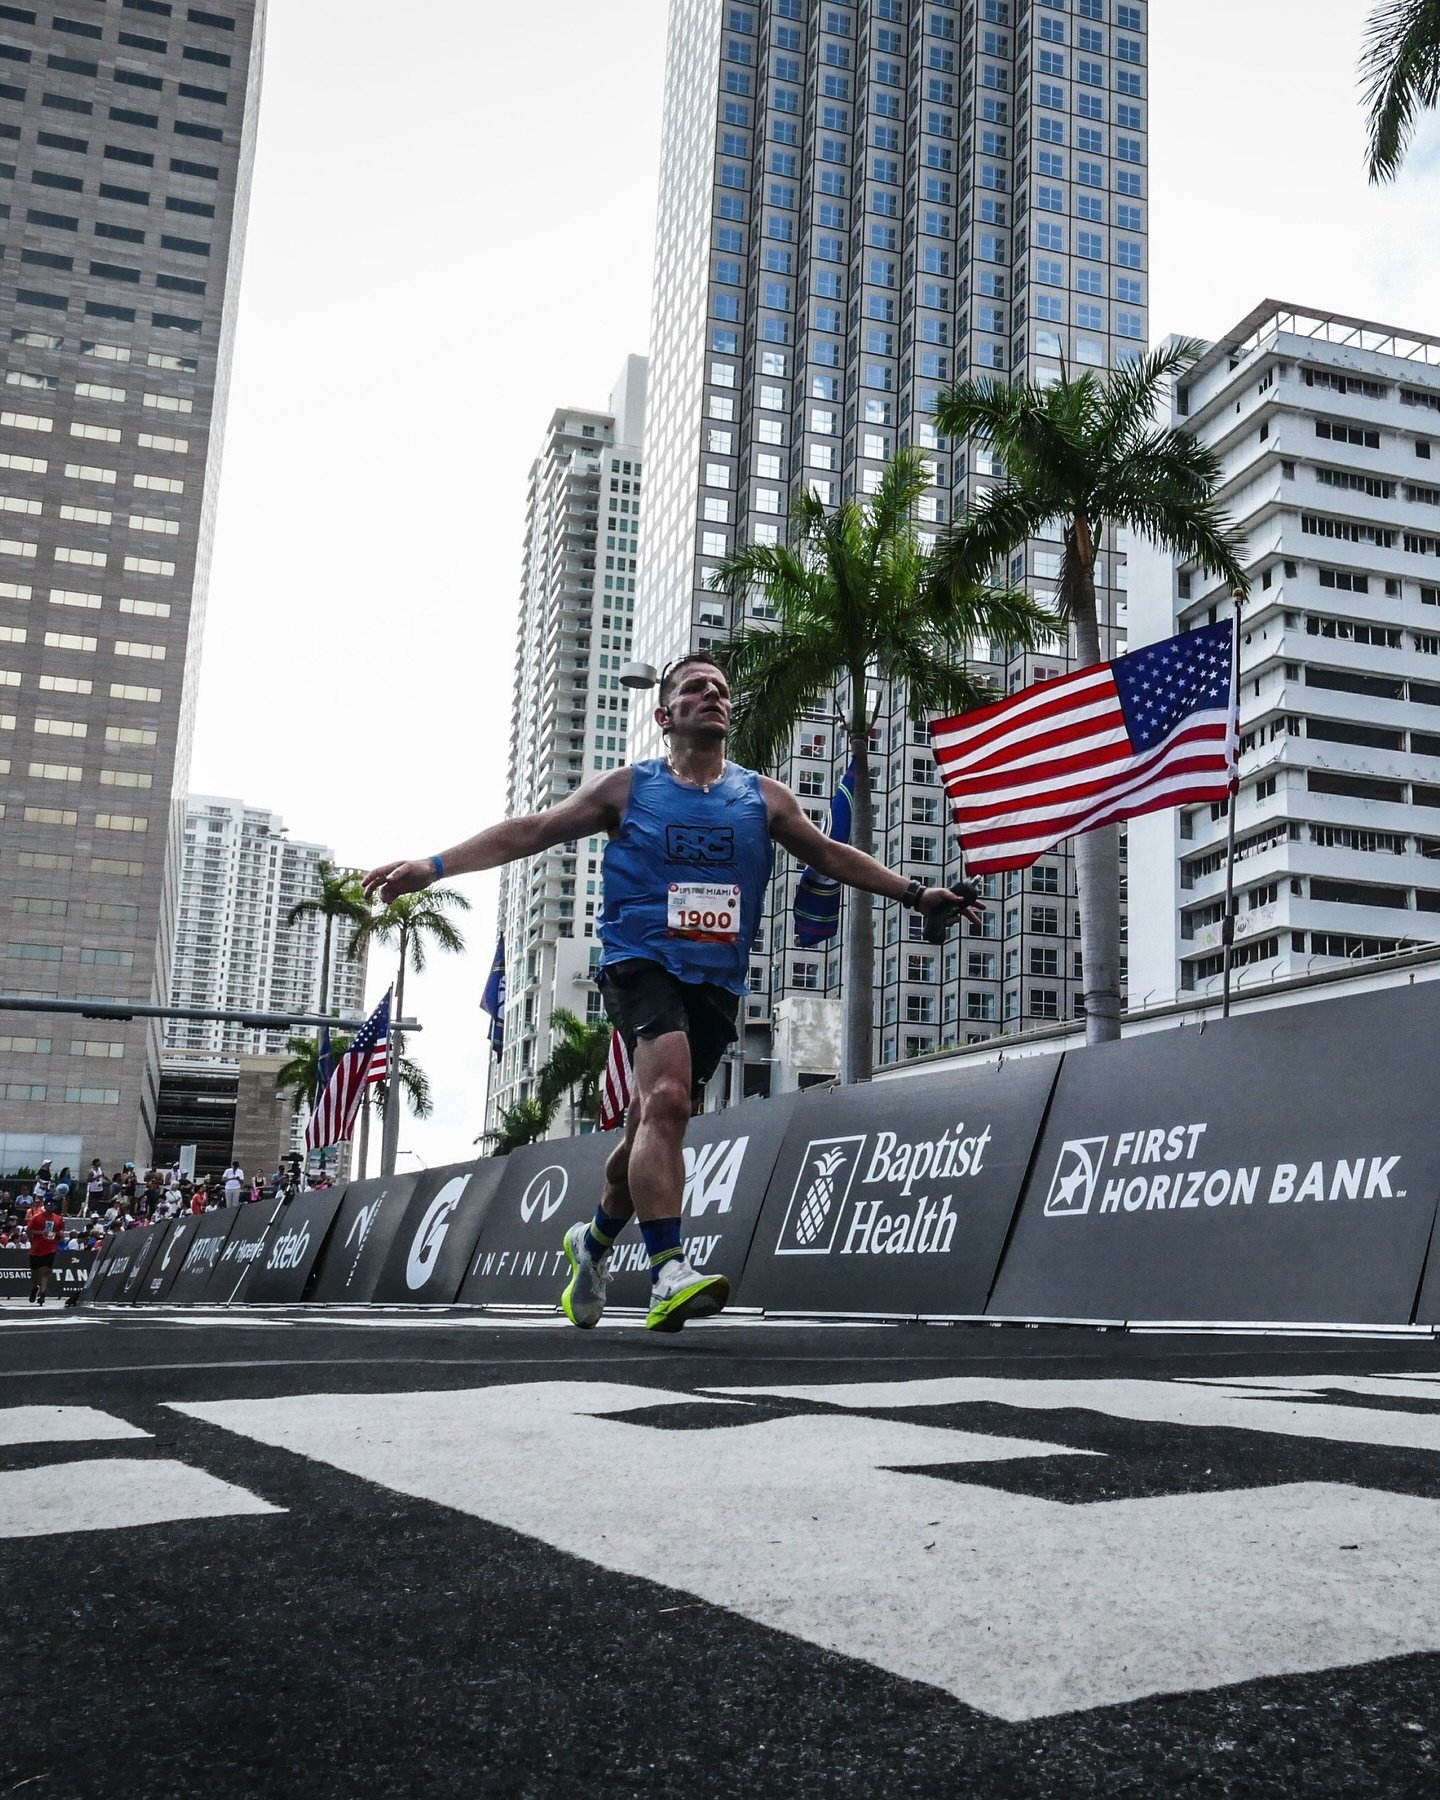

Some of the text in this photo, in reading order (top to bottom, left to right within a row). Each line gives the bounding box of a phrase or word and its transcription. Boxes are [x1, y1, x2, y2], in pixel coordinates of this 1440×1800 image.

[706, 888, 731, 896] MIAMI
[678, 910, 732, 929] 1900
[862, 1122, 991, 1198] Baptist
[1113, 1122, 1206, 1167] FIRST
[1101, 1165, 1258, 1213] HORIZON
[1268, 1154, 1401, 1205] BANK
[267, 1219, 310, 1270] stelo
[842, 1194, 959, 1256] Health
